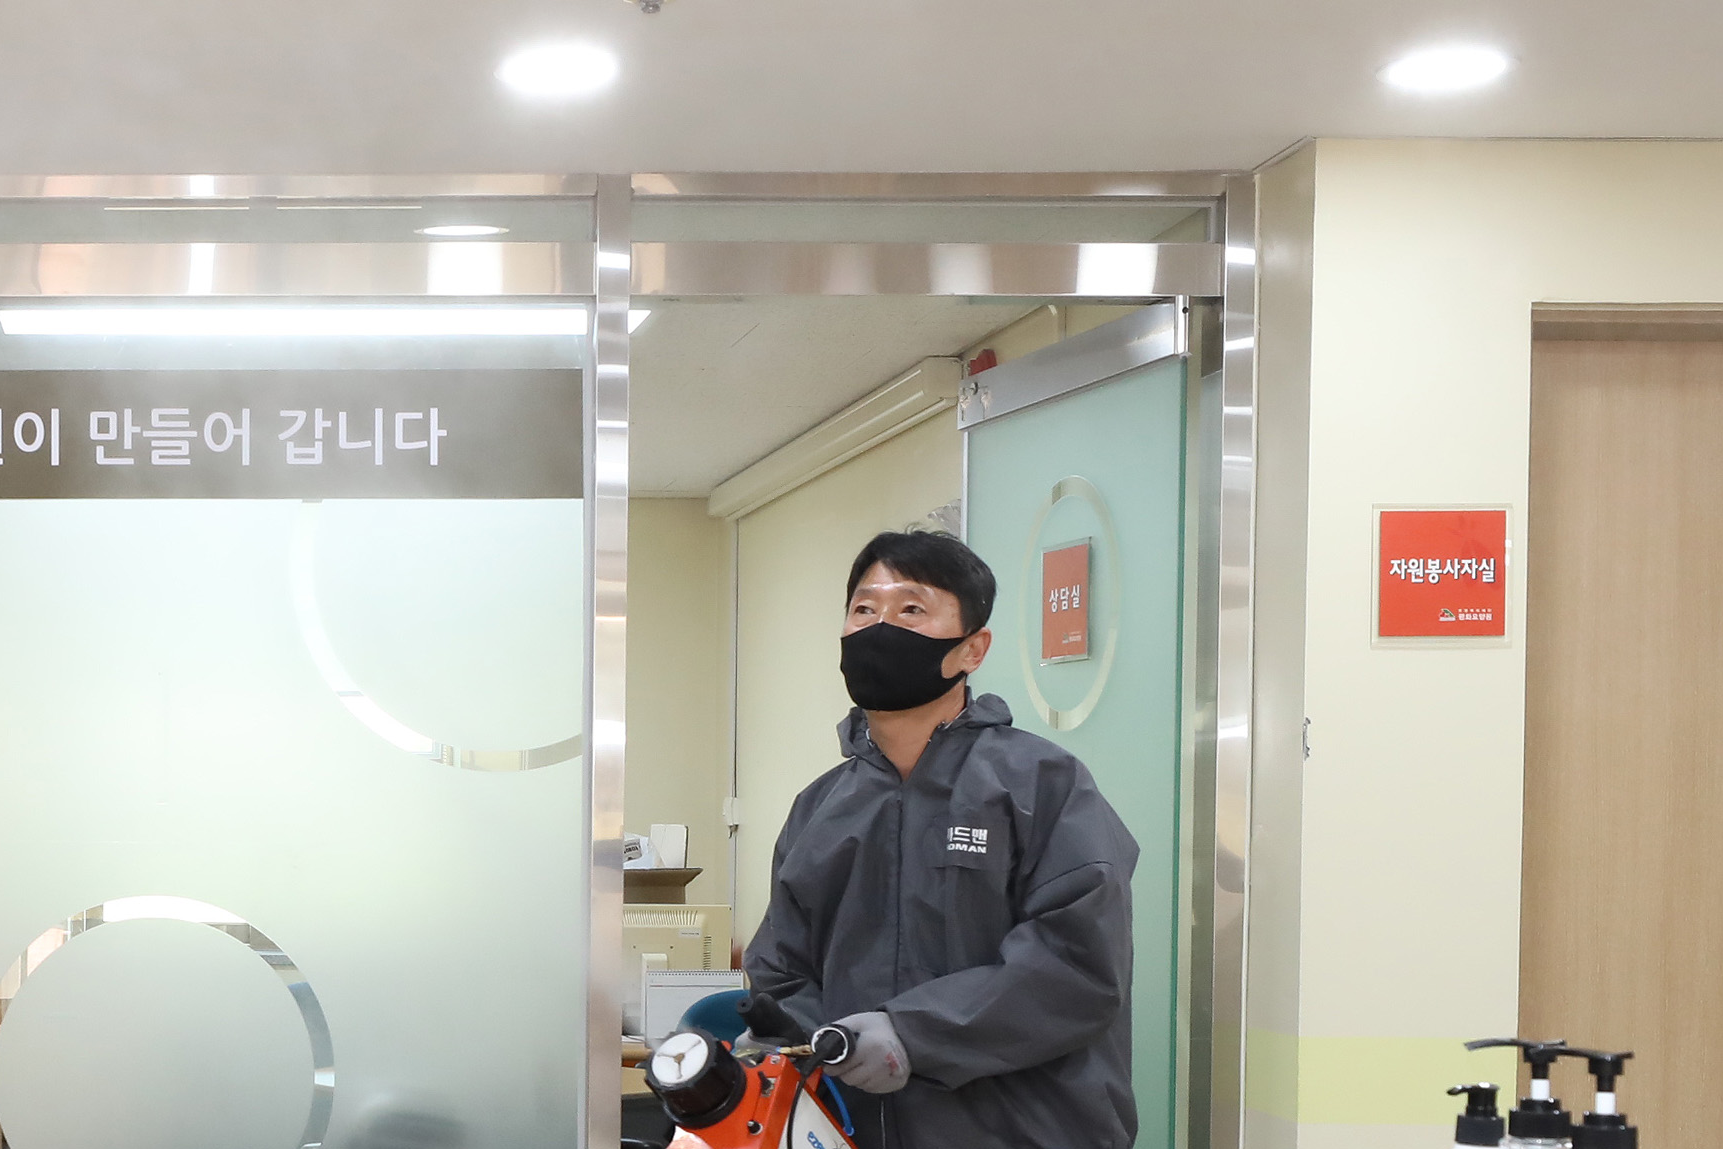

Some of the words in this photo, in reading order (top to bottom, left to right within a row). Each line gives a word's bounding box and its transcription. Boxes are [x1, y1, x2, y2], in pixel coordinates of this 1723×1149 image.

[88, 407, 252, 466] 만들어
[277, 407, 448, 466] 갑니다
[1389, 558, 1496, 584] 자원봉사자실
[1049, 584, 1080, 613] 상담실
